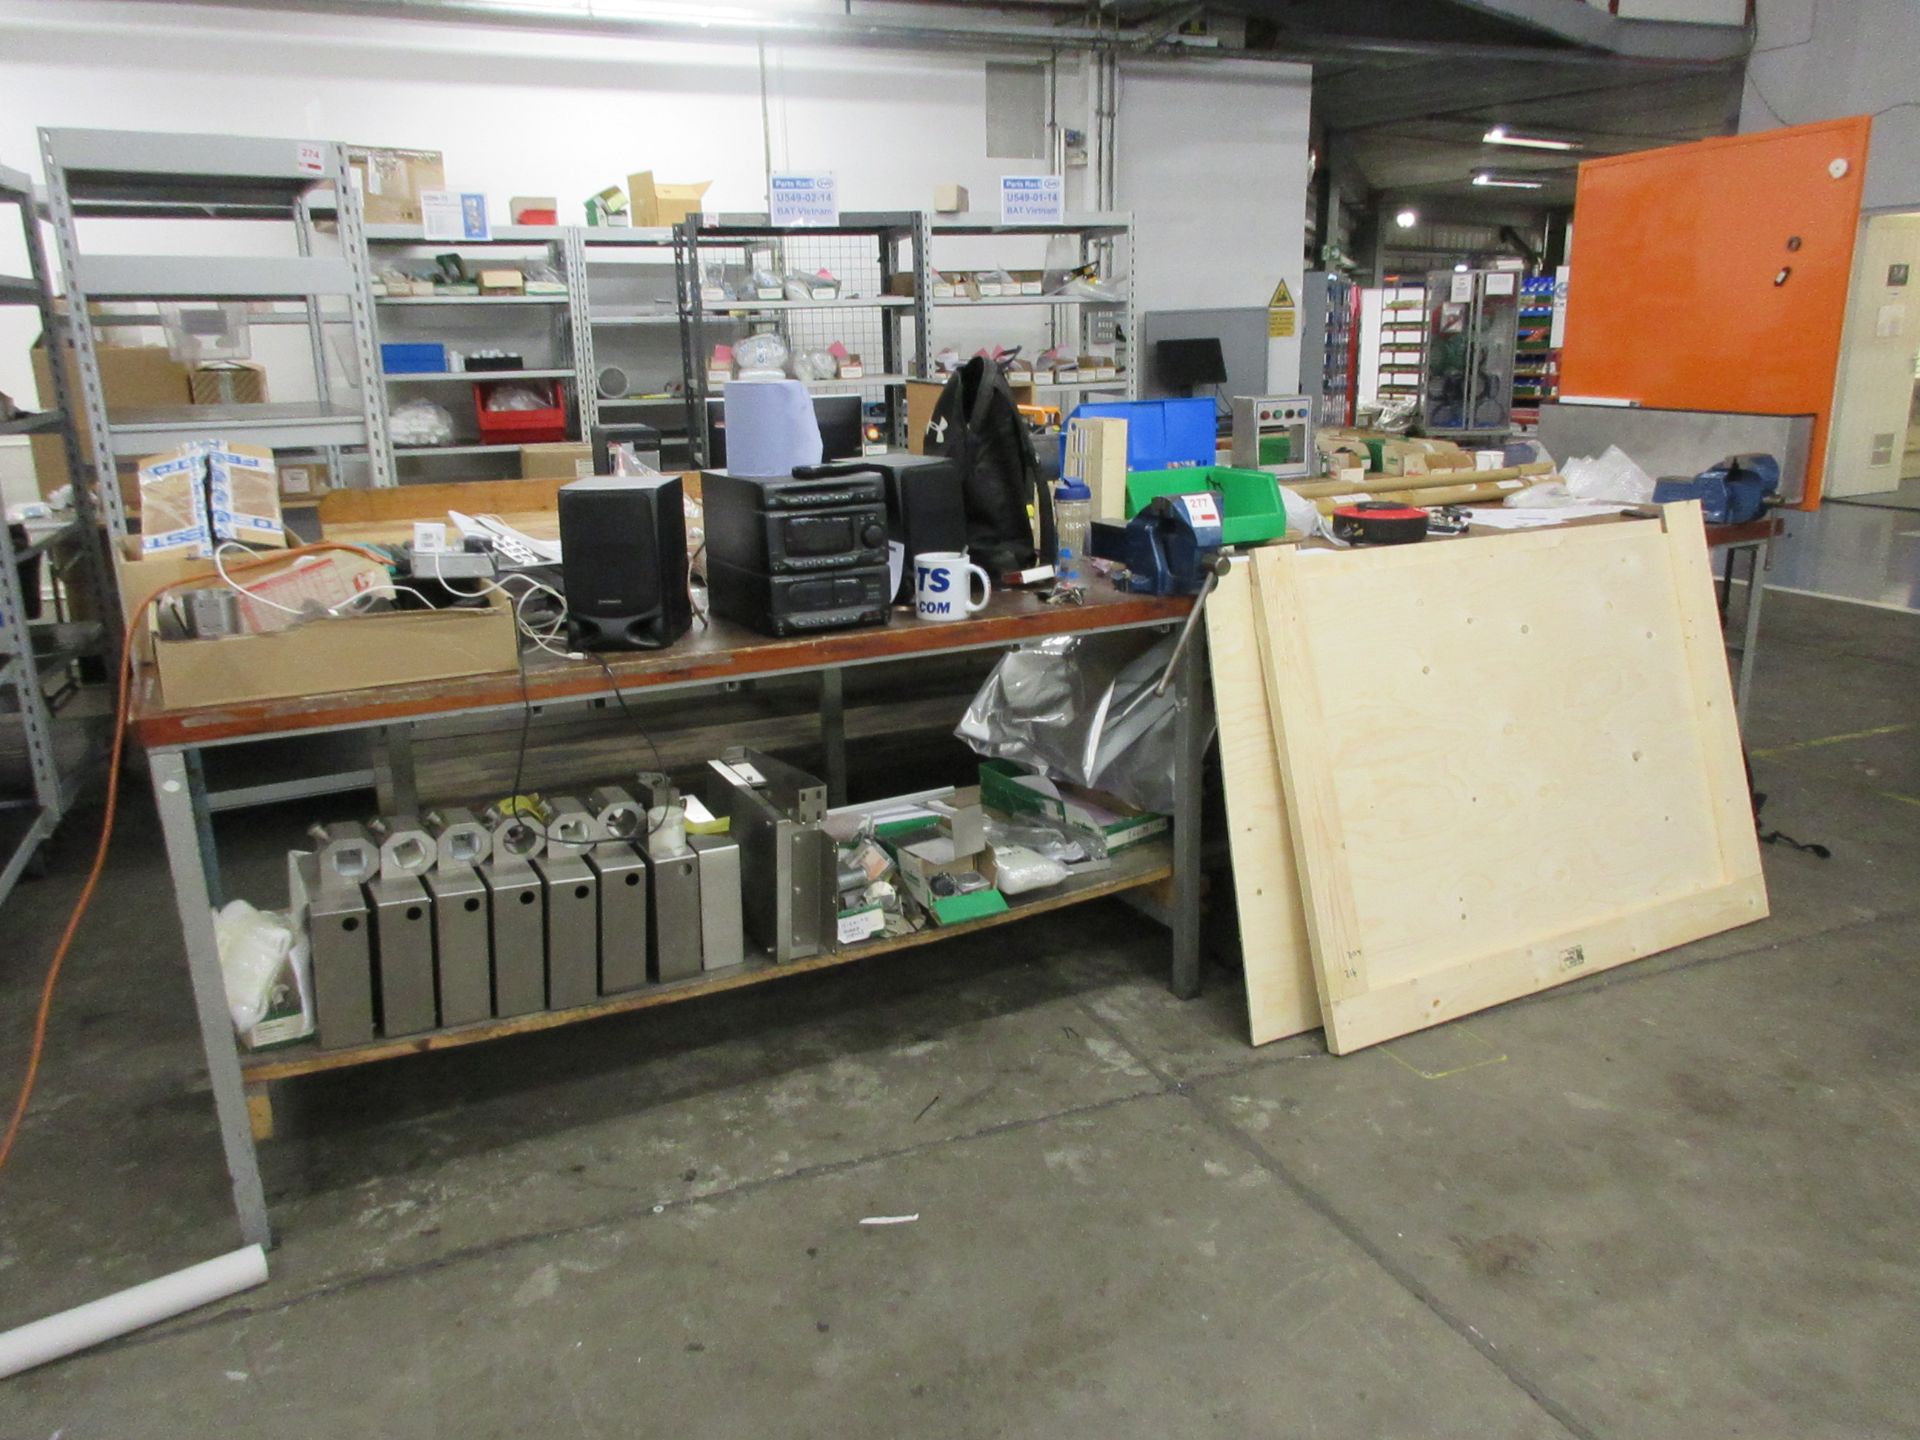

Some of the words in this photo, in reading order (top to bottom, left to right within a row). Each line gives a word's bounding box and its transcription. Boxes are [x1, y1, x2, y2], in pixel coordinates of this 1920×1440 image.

[775, 179, 794, 188] Parts
[795, 179, 814, 188] Rack
[1006, 180, 1024, 189] Parts
[1025, 180, 1041, 189] Rack
[797, 207, 833, 215] Vietnam
[1026, 206, 1058, 214] Vietnam
[1190, 498, 1207, 509] 277
[917, 566, 951, 593] TS
[919, 601, 951, 614] COM
